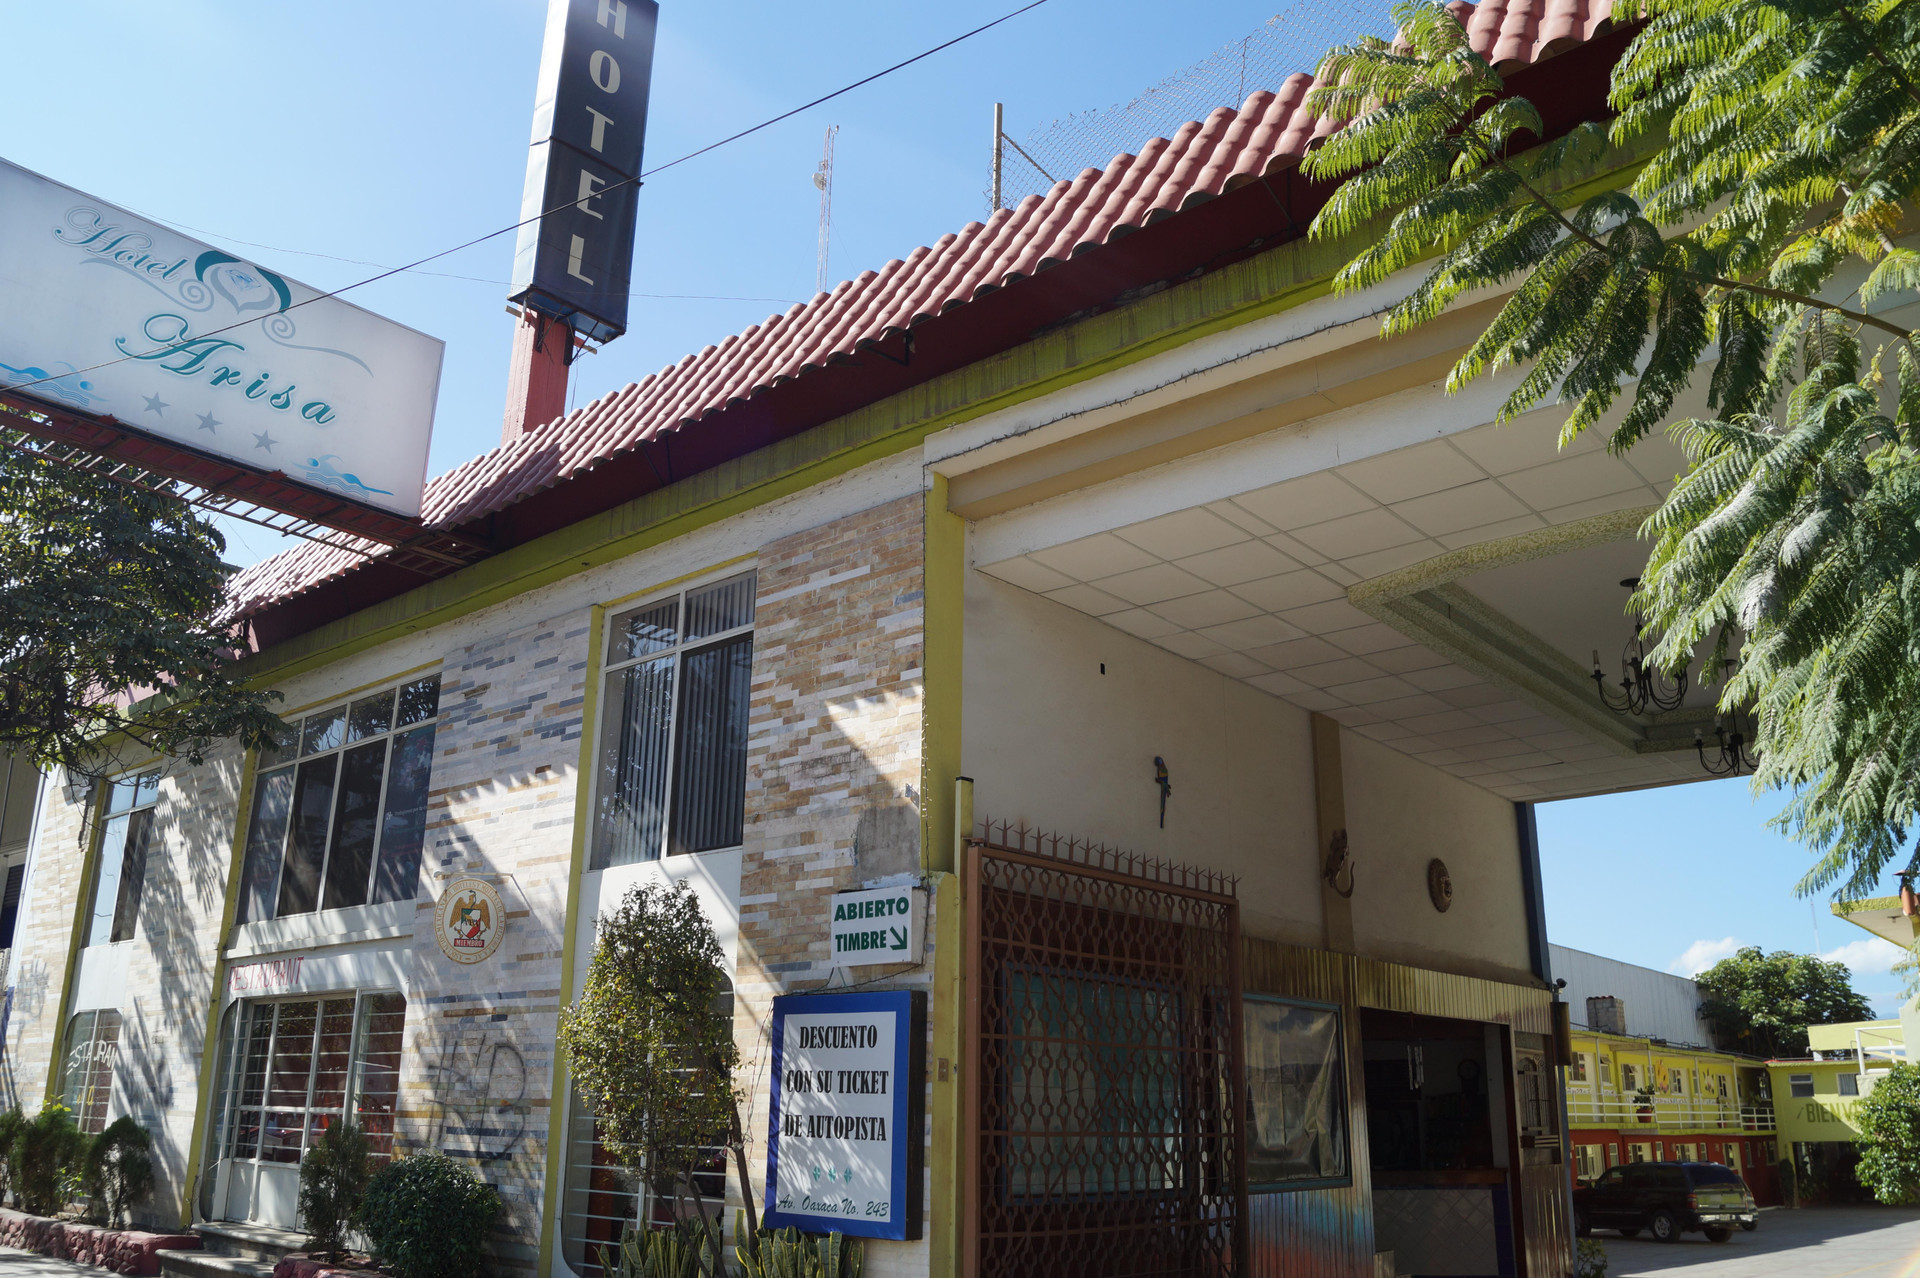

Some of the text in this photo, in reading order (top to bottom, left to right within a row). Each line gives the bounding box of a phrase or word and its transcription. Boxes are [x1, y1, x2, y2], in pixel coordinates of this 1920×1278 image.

[567, 0, 627, 286] HOTEL
[54, 205, 189, 282] Hotel
[834, 896, 909, 922] ABIERTO
[456, 939, 483, 947] MIEMBRO
[835, 930, 887, 953] TIMBRE
[227, 956, 305, 992] RESTAURANT
[799, 1024, 878, 1049] DESCUENTO
[786, 1069, 889, 1095] CON SU TICKET
[784, 1114, 887, 1142] DE AUTOPISTA
[777, 1193, 890, 1218] Av. Oaxaca No. 243
